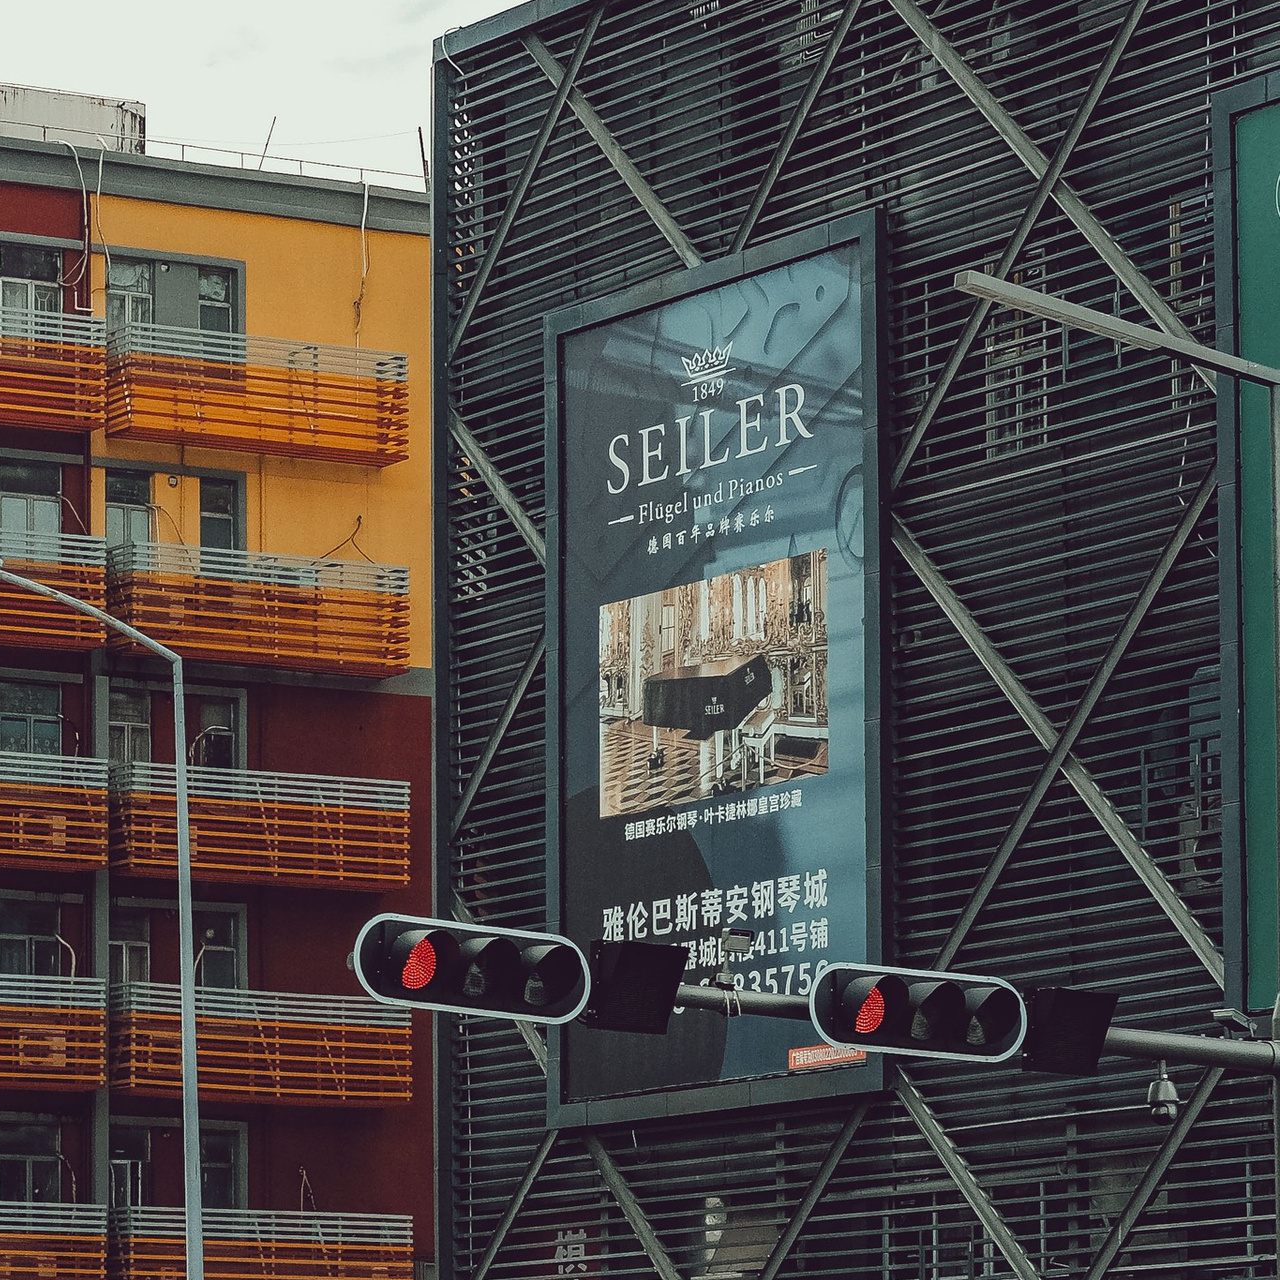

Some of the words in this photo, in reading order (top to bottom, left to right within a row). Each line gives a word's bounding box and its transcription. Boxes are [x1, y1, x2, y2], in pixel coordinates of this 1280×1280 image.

[692, 377, 724, 402] 1849
[606, 383, 814, 495] SEILER
[638, 491, 688, 524] Flügel
[693, 483, 724, 508] und
[728, 472, 783, 501] Pianos
[647, 505, 775, 555] 德国百年品牌赛乐尔
[704, 704, 725, 716] SEILER
[602, 868, 828, 941] 雅伦巴斯蒂安钢琴城
